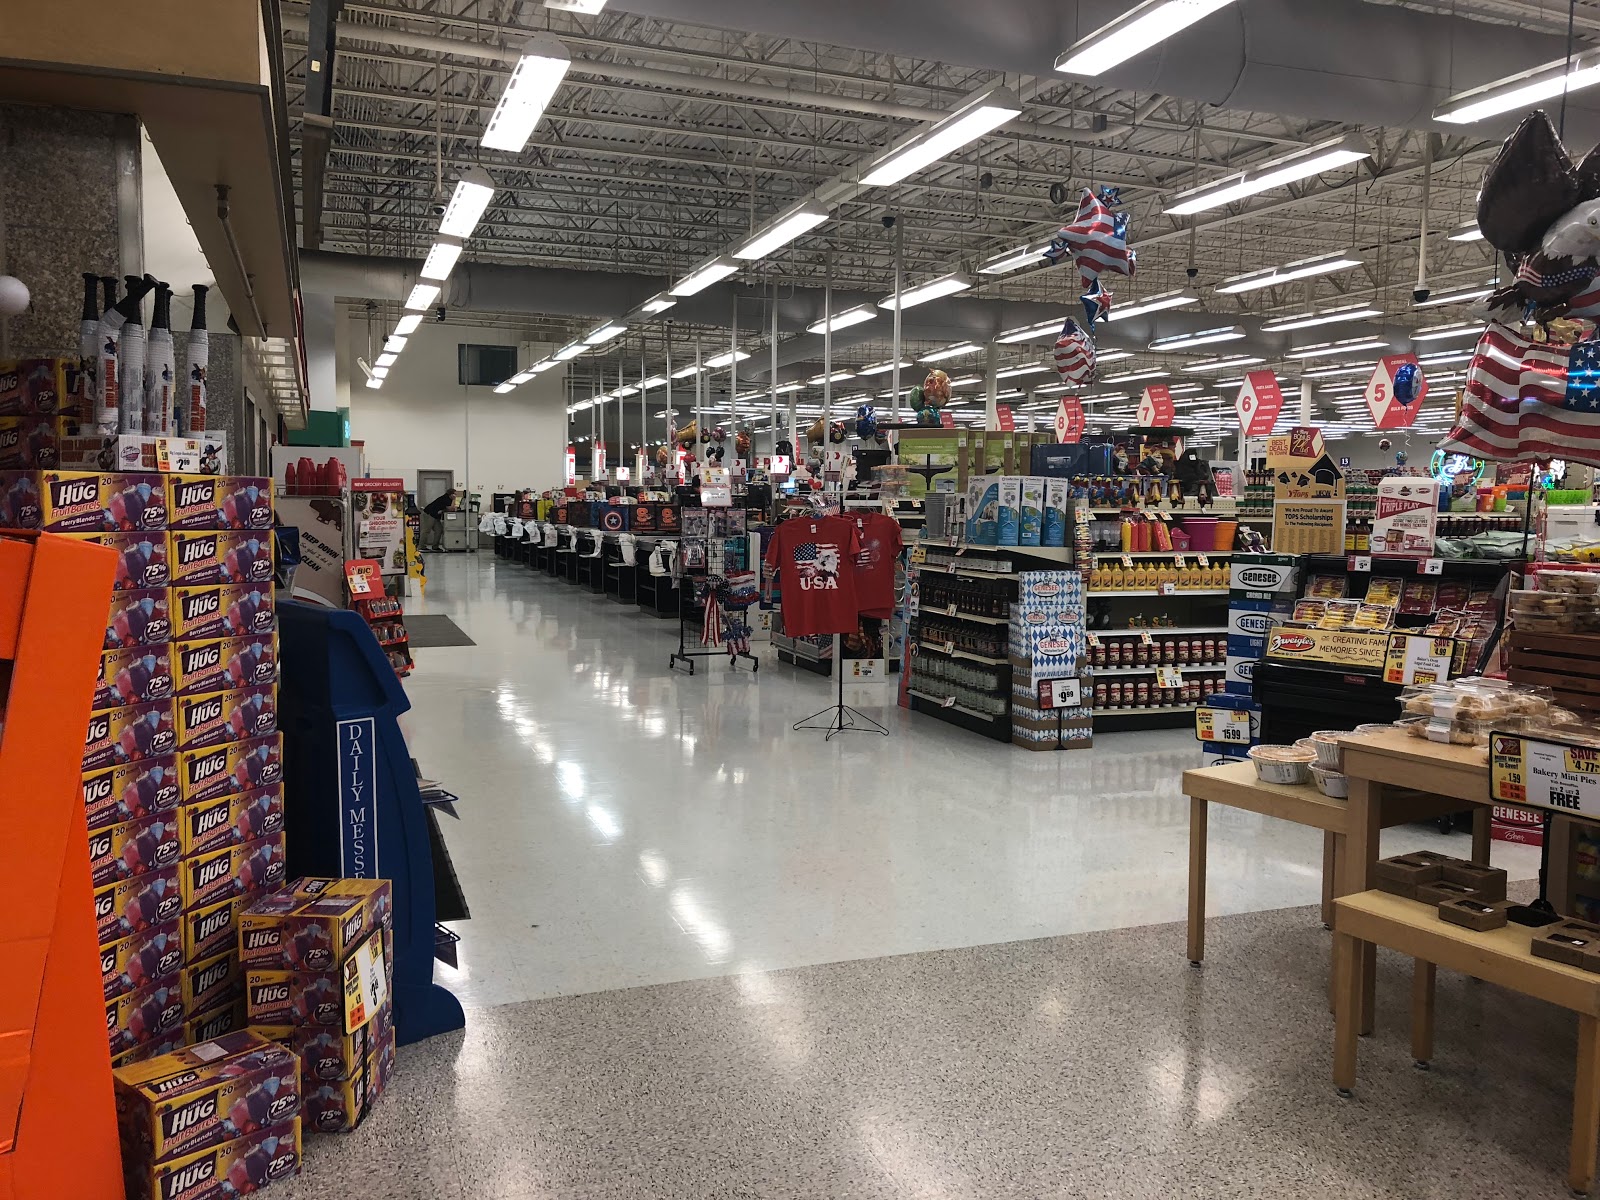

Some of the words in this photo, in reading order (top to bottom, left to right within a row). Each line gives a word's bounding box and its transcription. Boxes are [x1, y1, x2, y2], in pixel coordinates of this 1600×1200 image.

[1374, 384, 1386, 402] 5
[1242, 396, 1252, 412] 6
[1143, 407, 1149, 421] 7
[1058, 417, 1065, 429] 8
[740, 467, 746, 476] 6
[784, 464, 789, 473] 7
[58, 485, 97, 506] HUG
[180, 487, 212, 506] HUG
[21, 505, 38, 516] 75%
[144, 507, 165, 519] 75%
[251, 508, 269, 518] 75%
[1382, 502, 1403, 513] TRIPLE
[103, 538, 113, 546] 20
[301, 532, 320, 544] DEEP
[318, 543, 340, 558] DOWN
[184, 541, 215, 562] HUG
[145, 564, 166, 575] 75%
[252, 560, 270, 573] 75%
[301, 555, 321, 571] CLEAN
[188, 596, 218, 618] HUG
[147, 620, 168, 632] 75%
[1240, 618, 1274, 629] GENESEE
[1249, 639, 1263, 647] LIGHT
[1332, 636, 1368, 646] CREATING
[1369, 638, 1387, 646] FAMI
[1434, 639, 1450, 647] SAVE
[1319, 645, 1358, 655] MEMORIES
[1359, 648, 1380, 657] SINCE
[108, 655, 118, 663] 20
[188, 649, 219, 672] HUG
[255, 662, 273, 675] 75%
[149, 676, 170, 689] 75%
[1414, 675, 1436, 683] FREE
[112, 712, 122, 721] 20
[191, 702, 221, 727] HUG
[153, 731, 173, 745] 75%
[1570, 748, 1598, 760] SAVE
[194, 756, 225, 781] HUG
[349, 724, 363, 802] DAILY
[116, 769, 126, 779] 20
[1508, 773, 1520, 783] 1.59
[1533, 767, 1558, 779] Bakery
[1561, 772, 1578, 782] Mini
[1580, 775, 1597, 785] Pies
[157, 786, 177, 800] 75%
[1550, 791, 1581, 811] FREE
[197, 808, 228, 834] HUG
[1493, 806, 1541, 823] GENESEE
[1504, 831, 1527, 842] Beer
[90, 839, 110, 859] UG
[199, 860, 229, 887] HUG
[200, 911, 229, 938] HUG
[345, 914, 362, 944] HUG
[248, 932, 280, 949] HUG
[308, 949, 329, 959] 75%
[249, 976, 260, 984] 20
[257, 987, 289, 1004] HUG
[318, 1003, 339, 1013] 75%
[318, 1058, 340, 1069] 75%
[221, 1086, 234, 1097] 20
[270, 1094, 296, 1114] 75%
[170, 1098, 215, 1135] HUG
[319, 1110, 342, 1121] 75%
[220, 1146, 232, 1159] 20
[268, 1153, 294, 1173] 75%
[169, 1160, 213, 1198] HUG
